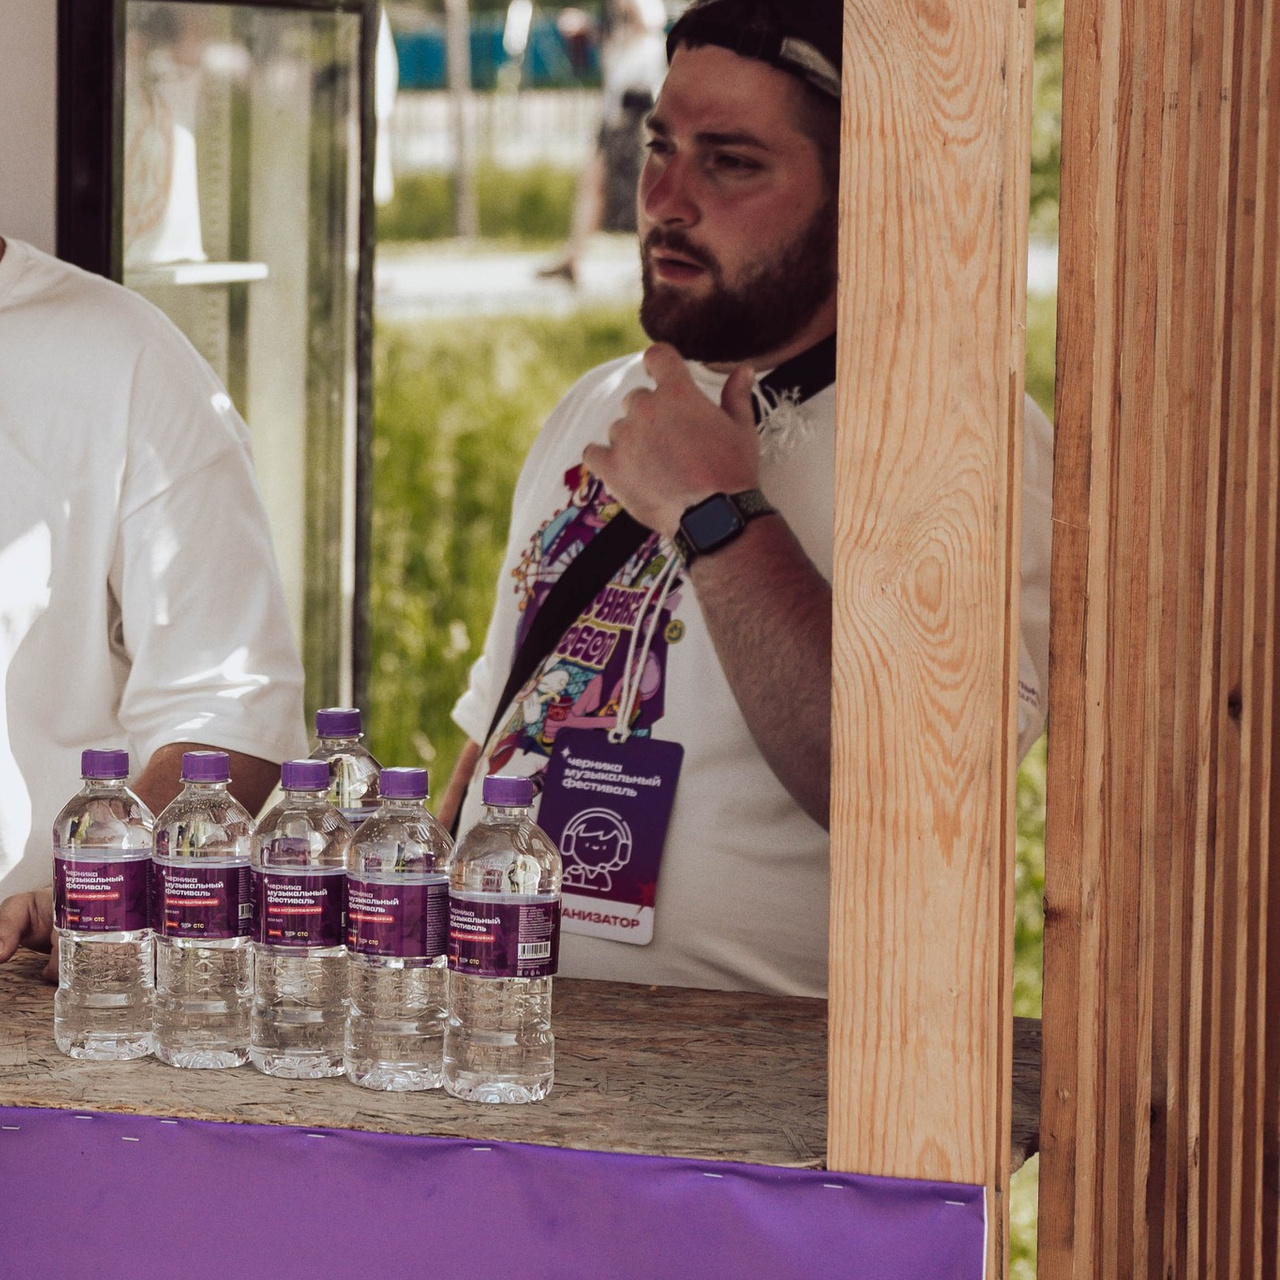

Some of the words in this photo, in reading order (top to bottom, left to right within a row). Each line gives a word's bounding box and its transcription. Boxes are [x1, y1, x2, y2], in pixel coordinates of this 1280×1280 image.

[567, 757, 623, 773] черника
[563, 767, 662, 787] музыкальный
[562, 777, 638, 798] фестиваль
[65, 875, 124, 884] музыкальный
[65, 882, 111, 891] фестиваль
[165, 881, 224, 890] музыкальный
[267, 883, 302, 891] черника
[165, 888, 211, 897] фестиваль
[267, 888, 328, 898] музыкальный
[267, 896, 315, 905] фестиваль
[561, 907, 640, 930] АНИЗАТОР
